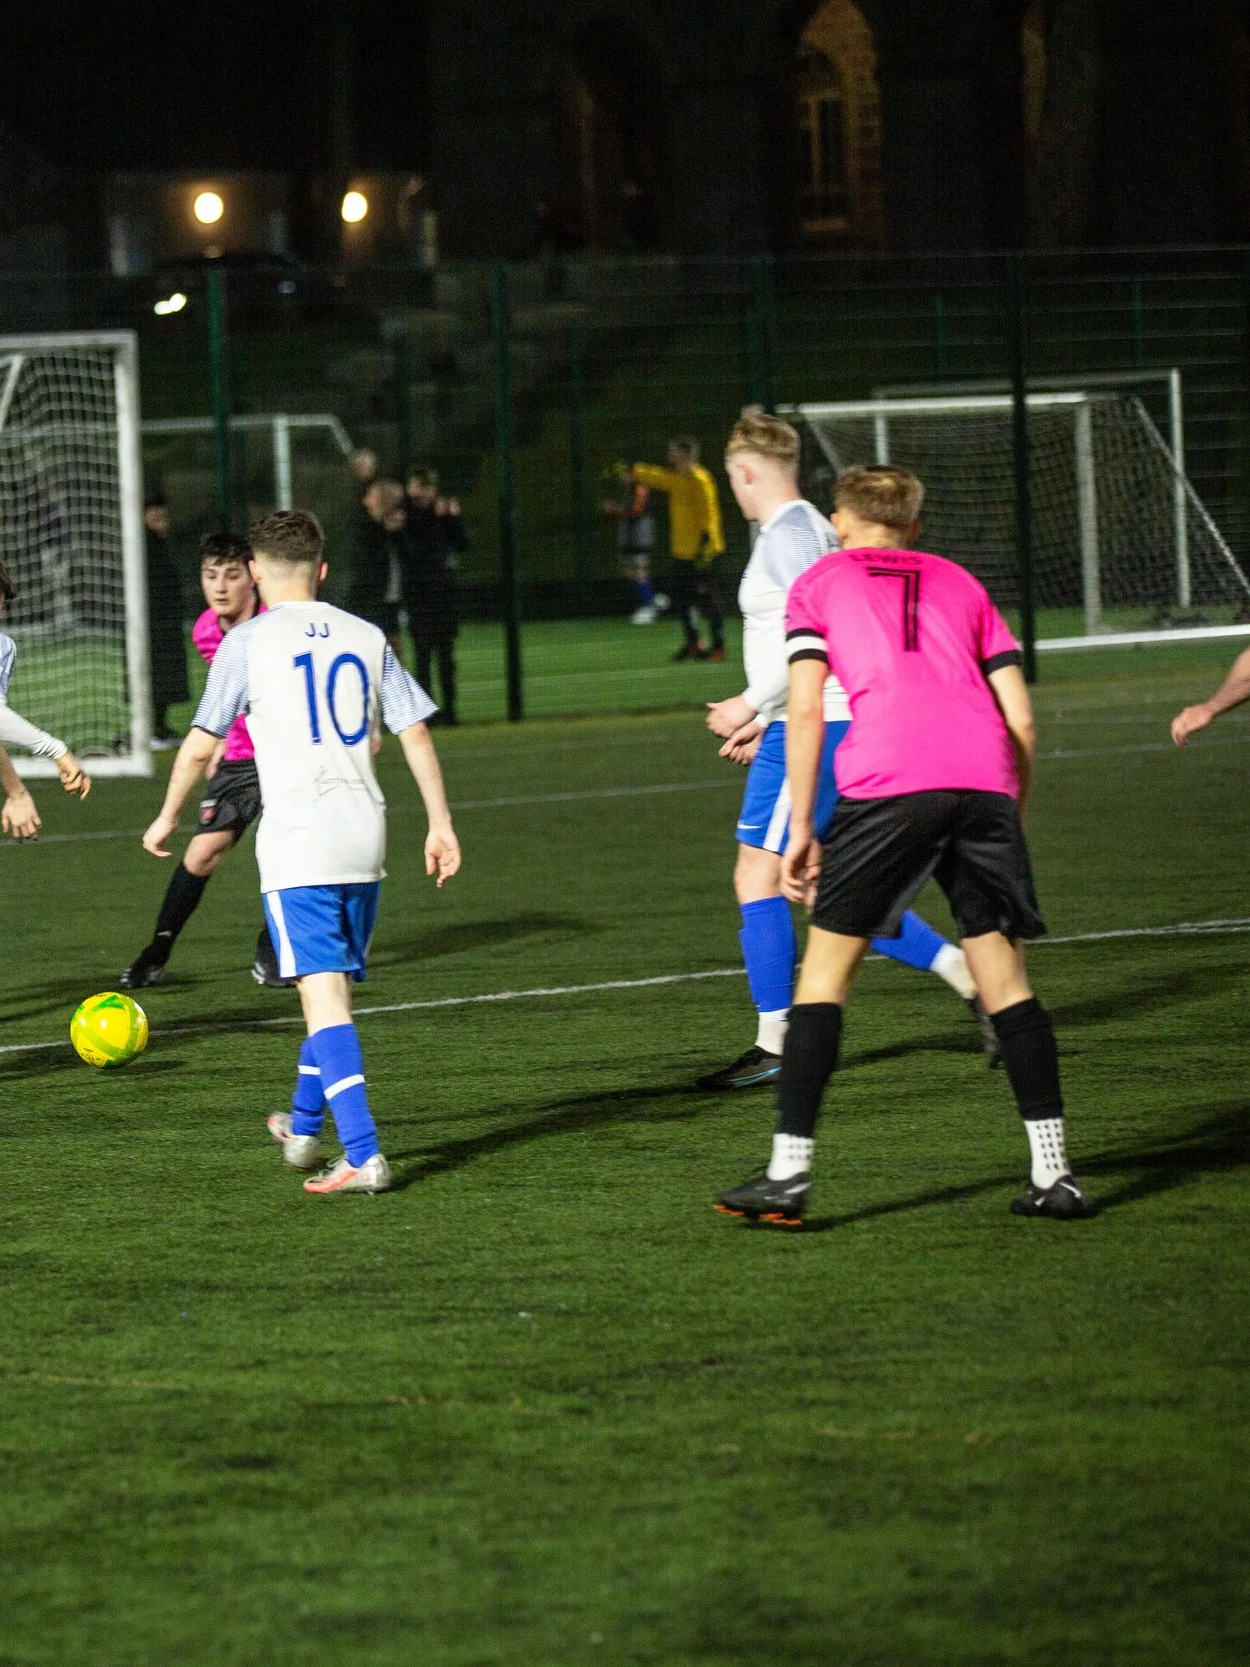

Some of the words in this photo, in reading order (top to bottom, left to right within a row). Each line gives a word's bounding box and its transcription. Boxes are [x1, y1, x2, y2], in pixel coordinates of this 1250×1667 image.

[304, 622, 331, 639] JJ
[866, 566, 921, 652] 7
[293, 651, 370, 747] 10
